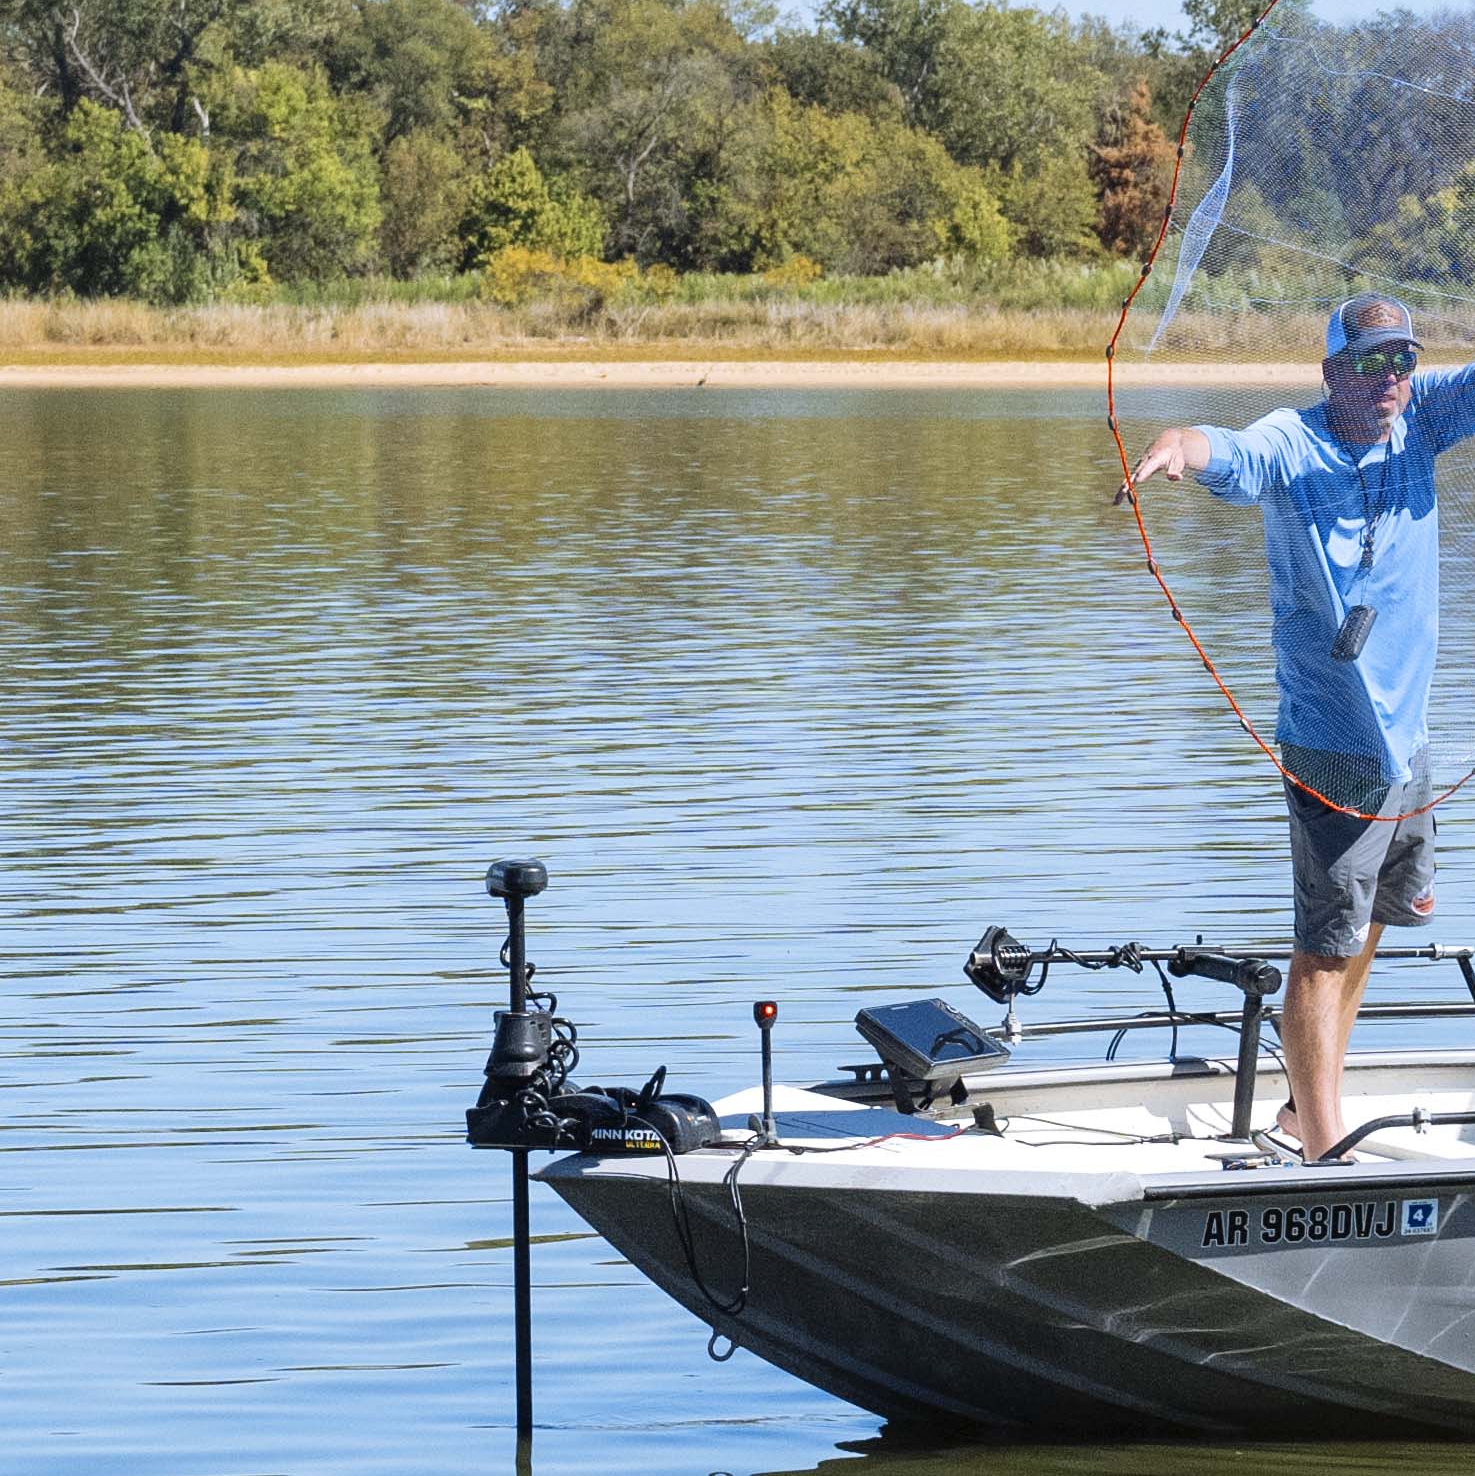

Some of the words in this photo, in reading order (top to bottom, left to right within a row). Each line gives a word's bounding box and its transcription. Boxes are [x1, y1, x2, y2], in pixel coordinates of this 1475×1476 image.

[624, 1129, 661, 1141] KOTA
[1201, 1209, 1250, 1248] AR
[1260, 1201, 1397, 1244] 968DVJ
